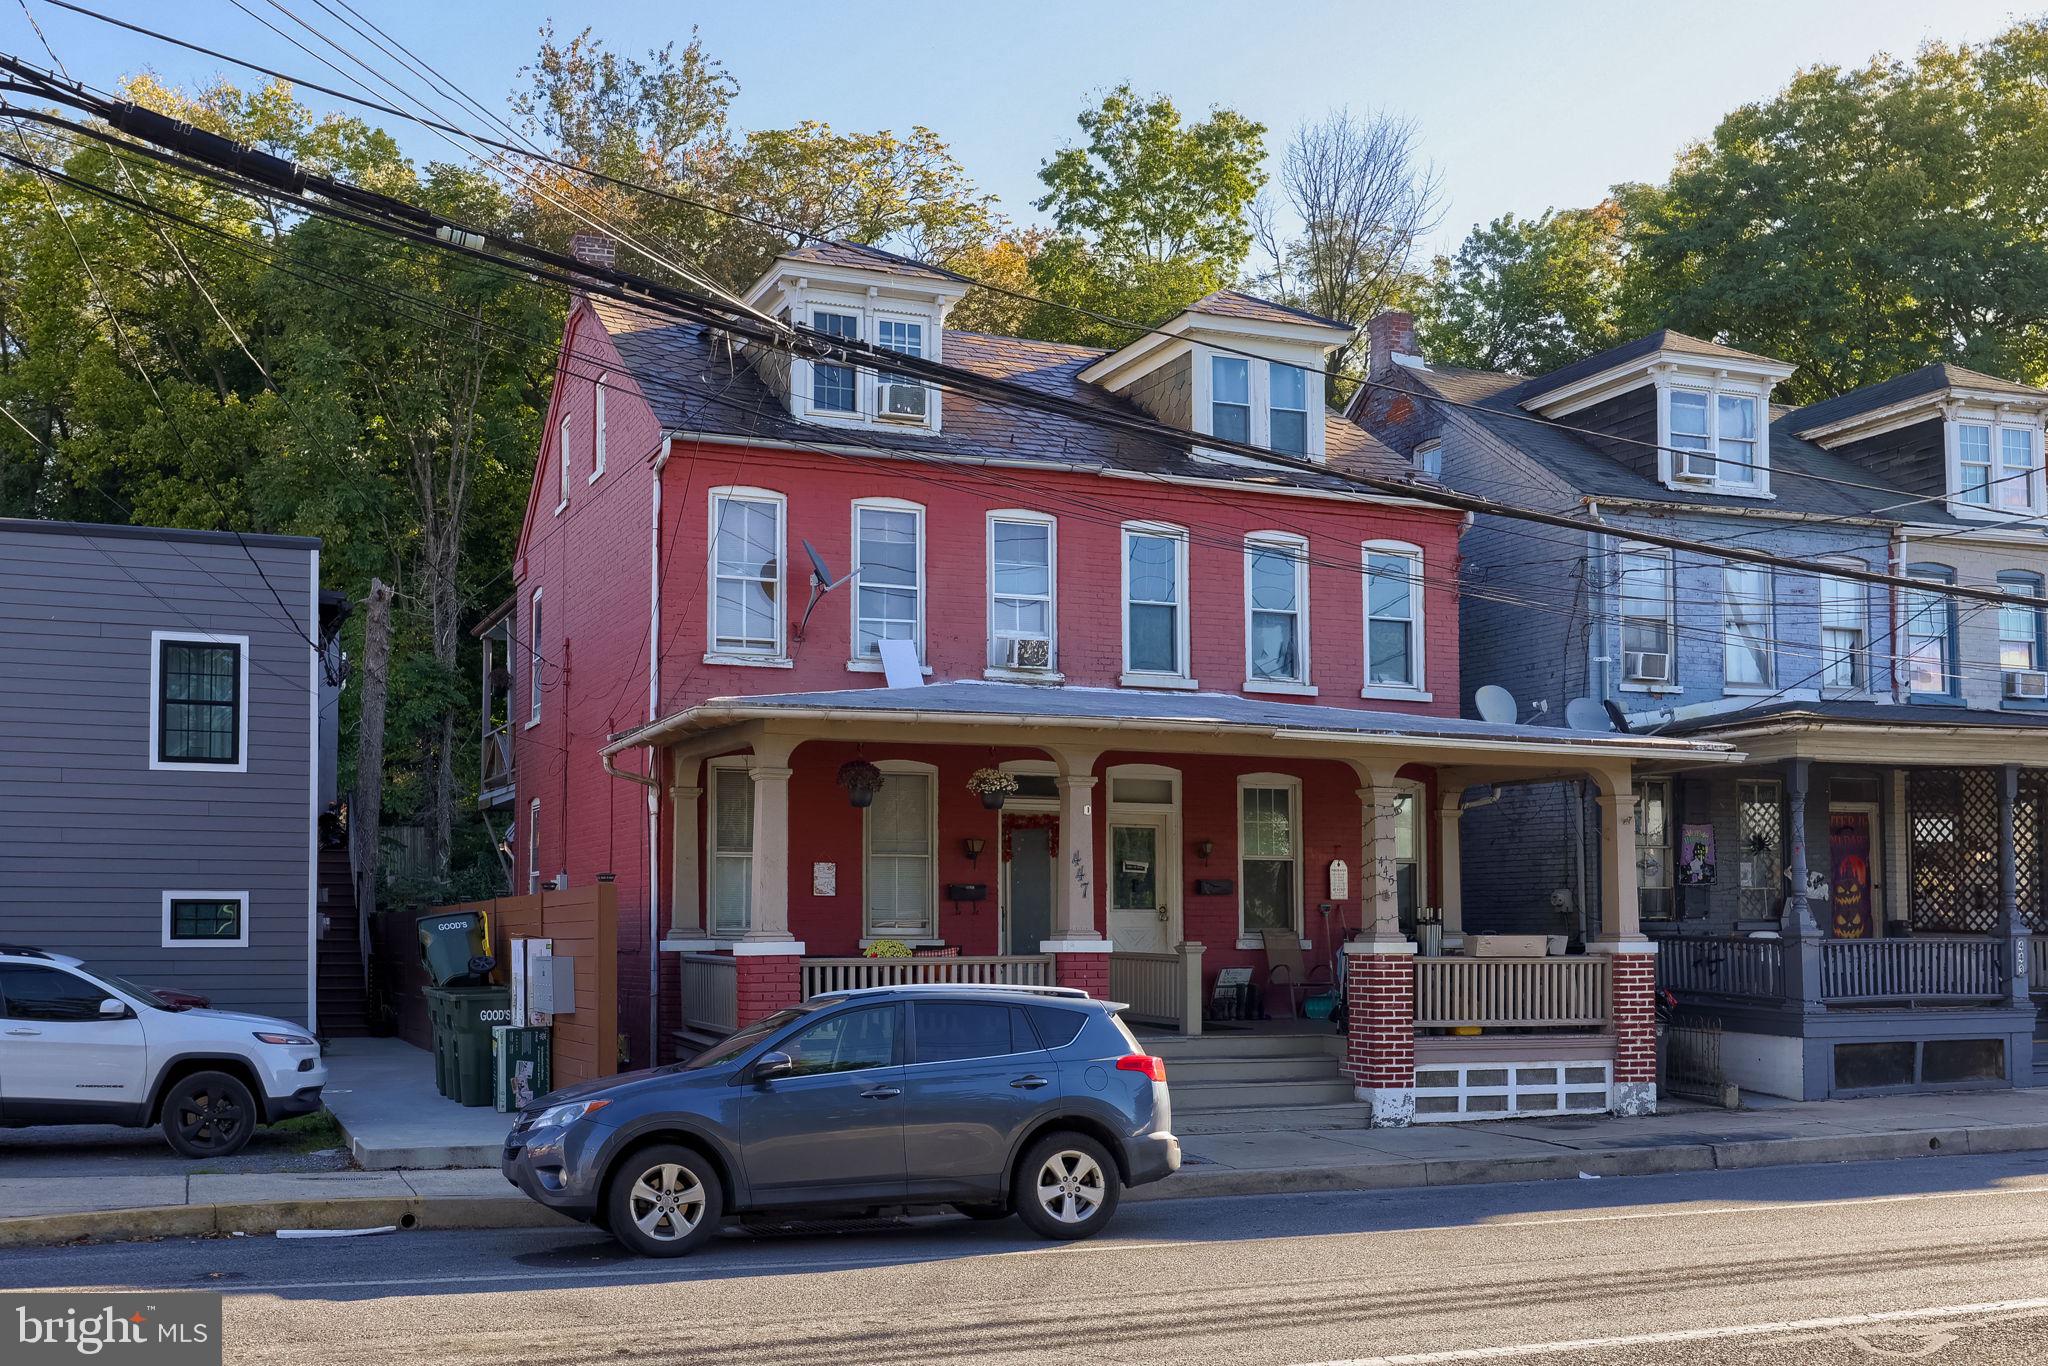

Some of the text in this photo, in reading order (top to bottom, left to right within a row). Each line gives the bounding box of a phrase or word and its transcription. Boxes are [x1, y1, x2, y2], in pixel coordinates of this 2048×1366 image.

[1071, 849, 1089, 898] 447
[1378, 855, 1395, 886] 445
[438, 921, 468, 931] GOOD'S
[2017, 940, 2025, 975] 443
[480, 1009, 511, 1021] GOOD'S
